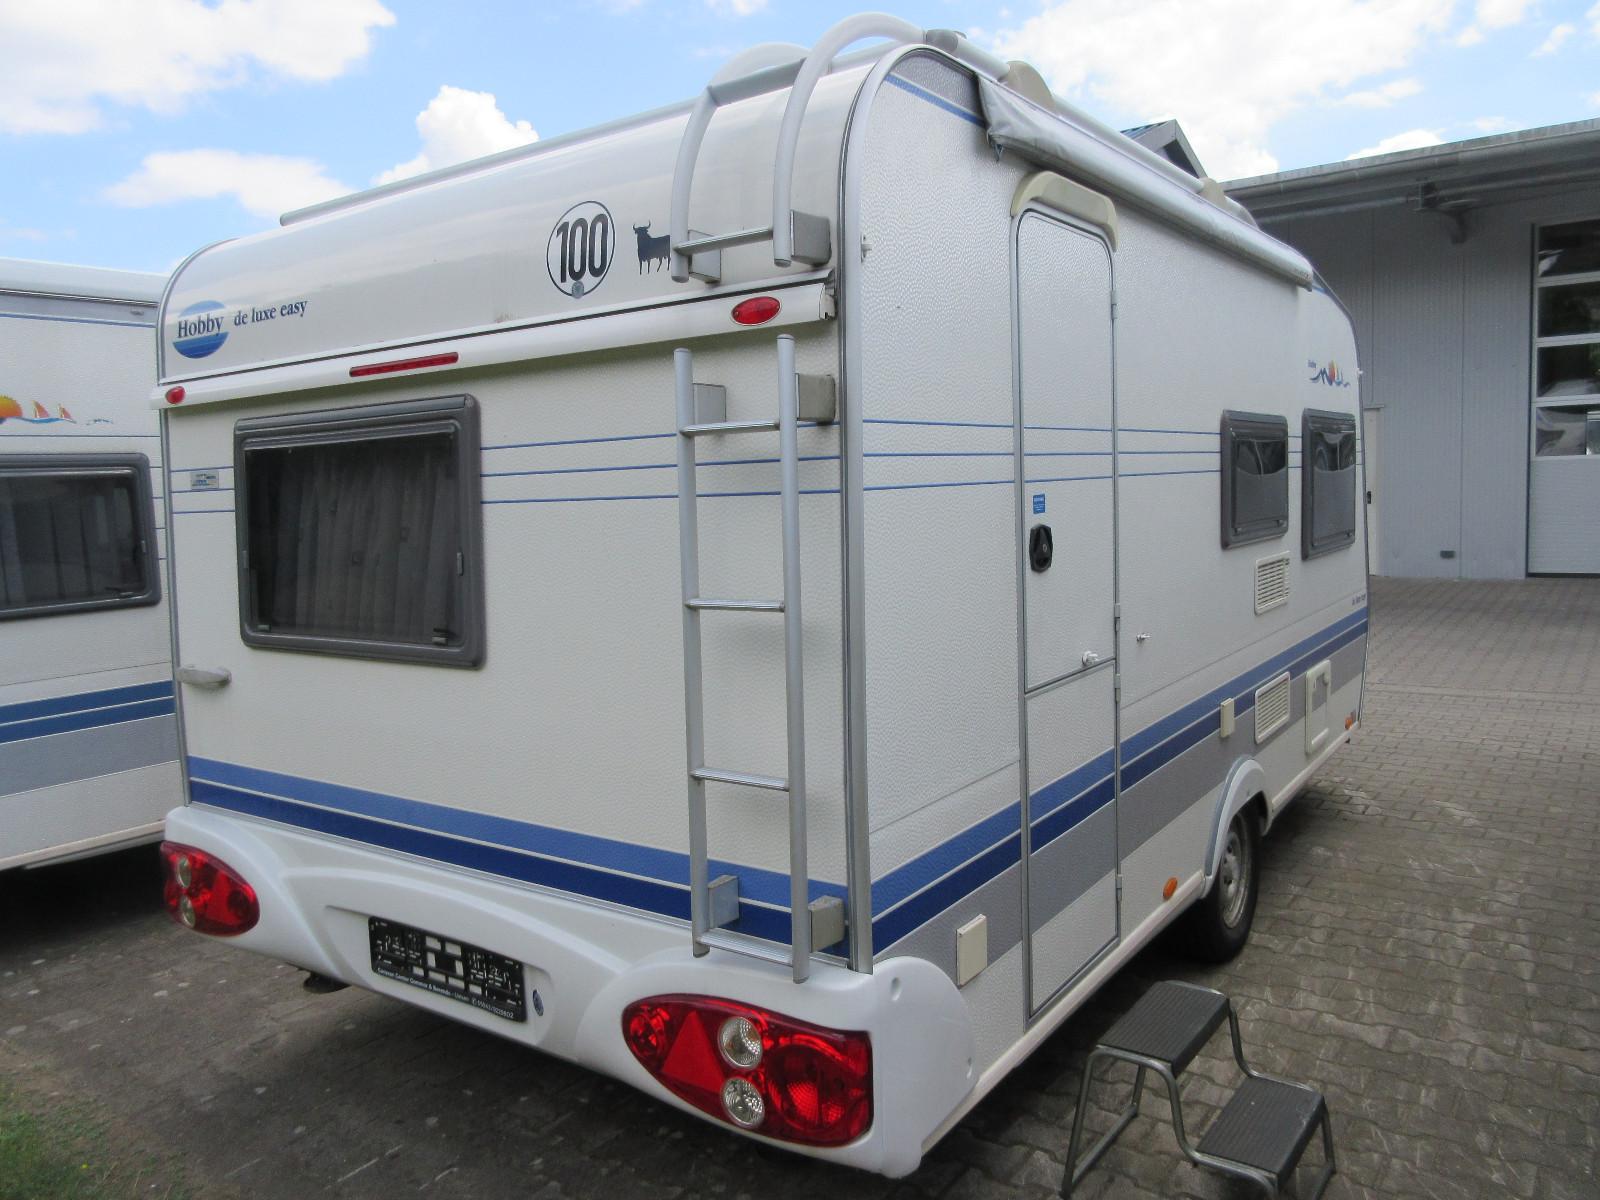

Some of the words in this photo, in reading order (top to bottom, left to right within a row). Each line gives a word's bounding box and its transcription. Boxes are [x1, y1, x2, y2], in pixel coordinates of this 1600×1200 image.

[556, 213, 608, 283] 100
[177, 313, 224, 338] Hobby
[233, 310, 248, 326] de
[251, 306, 277, 323] luxe
[280, 300, 308, 318] easy
